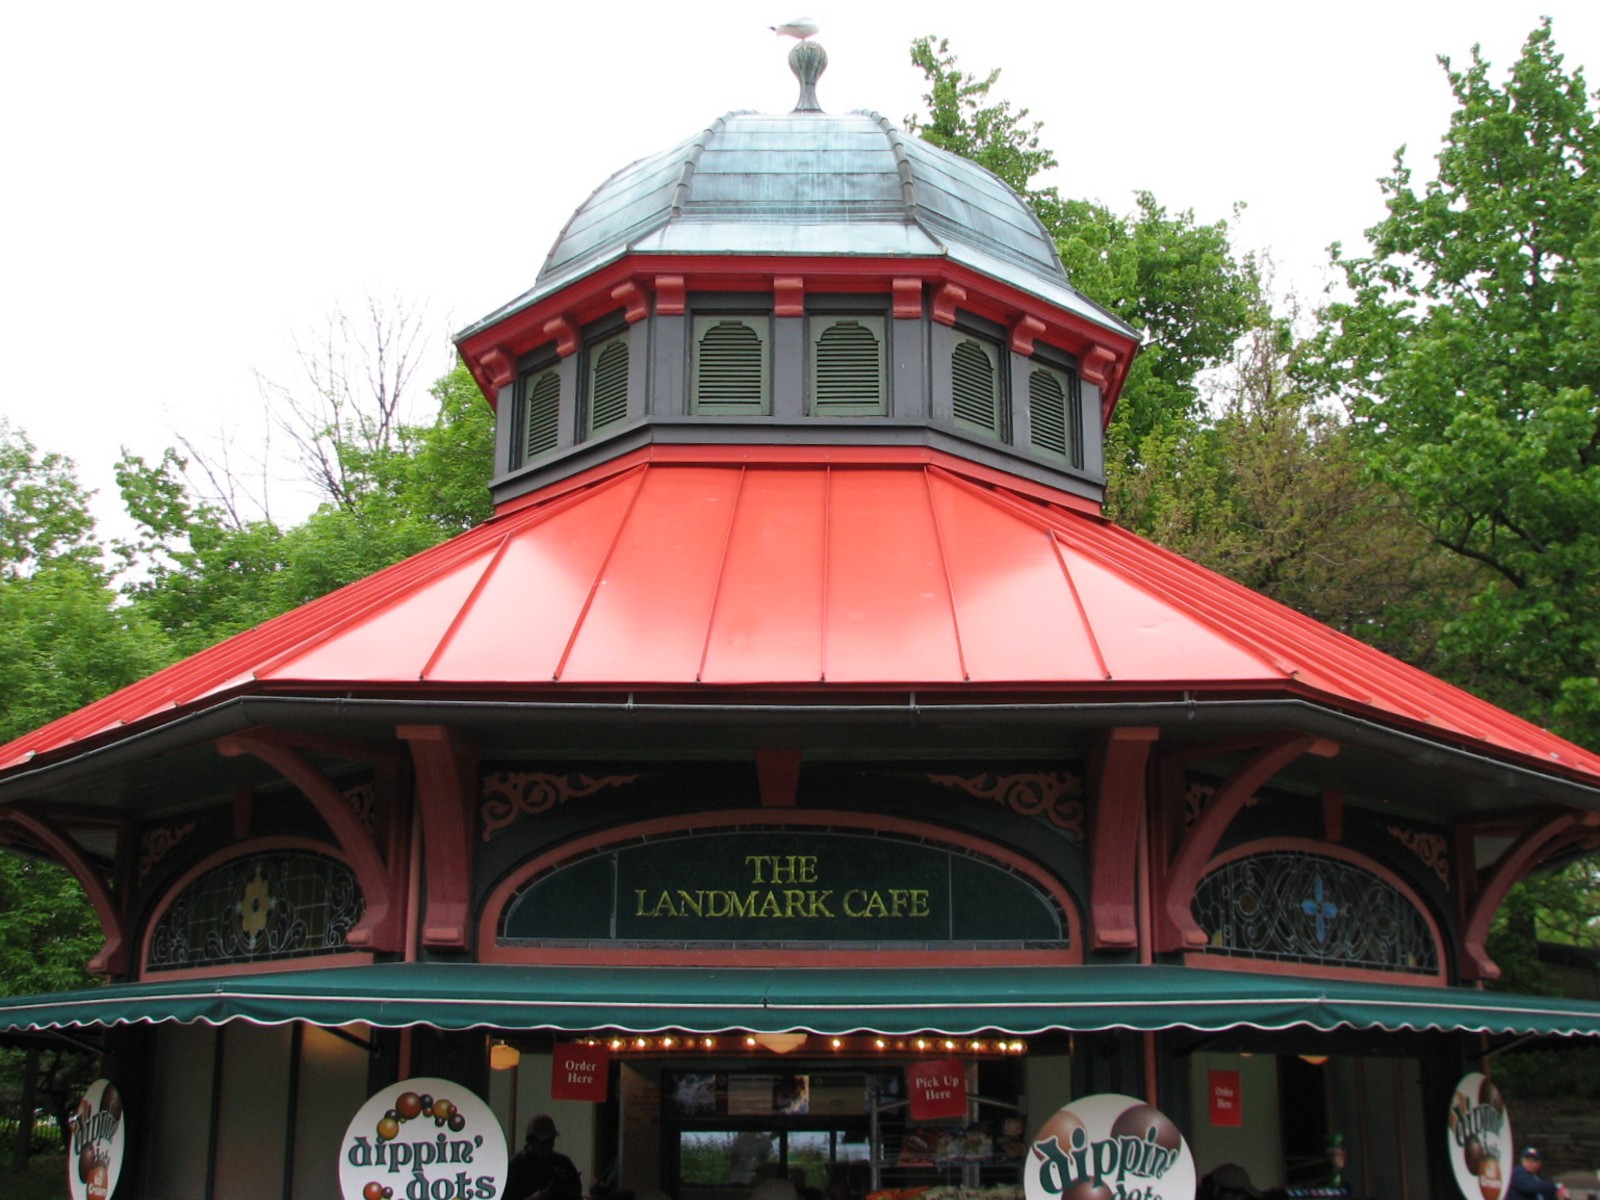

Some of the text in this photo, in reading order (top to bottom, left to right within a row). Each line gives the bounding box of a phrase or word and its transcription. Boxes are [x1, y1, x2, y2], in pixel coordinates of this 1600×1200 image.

[745, 855, 818, 883] THE
[634, 889, 930, 918] LANDMARK CAFE
[565, 1060, 597, 1071] Order
[568, 1073, 593, 1084] Here
[915, 1075, 959, 1088] Pick Up
[925, 1090, 952, 1100] Here
[348, 1133, 483, 1173] dippin'
[1034, 1126, 1177, 1194] dippin'
[406, 1171, 497, 1200] dots
